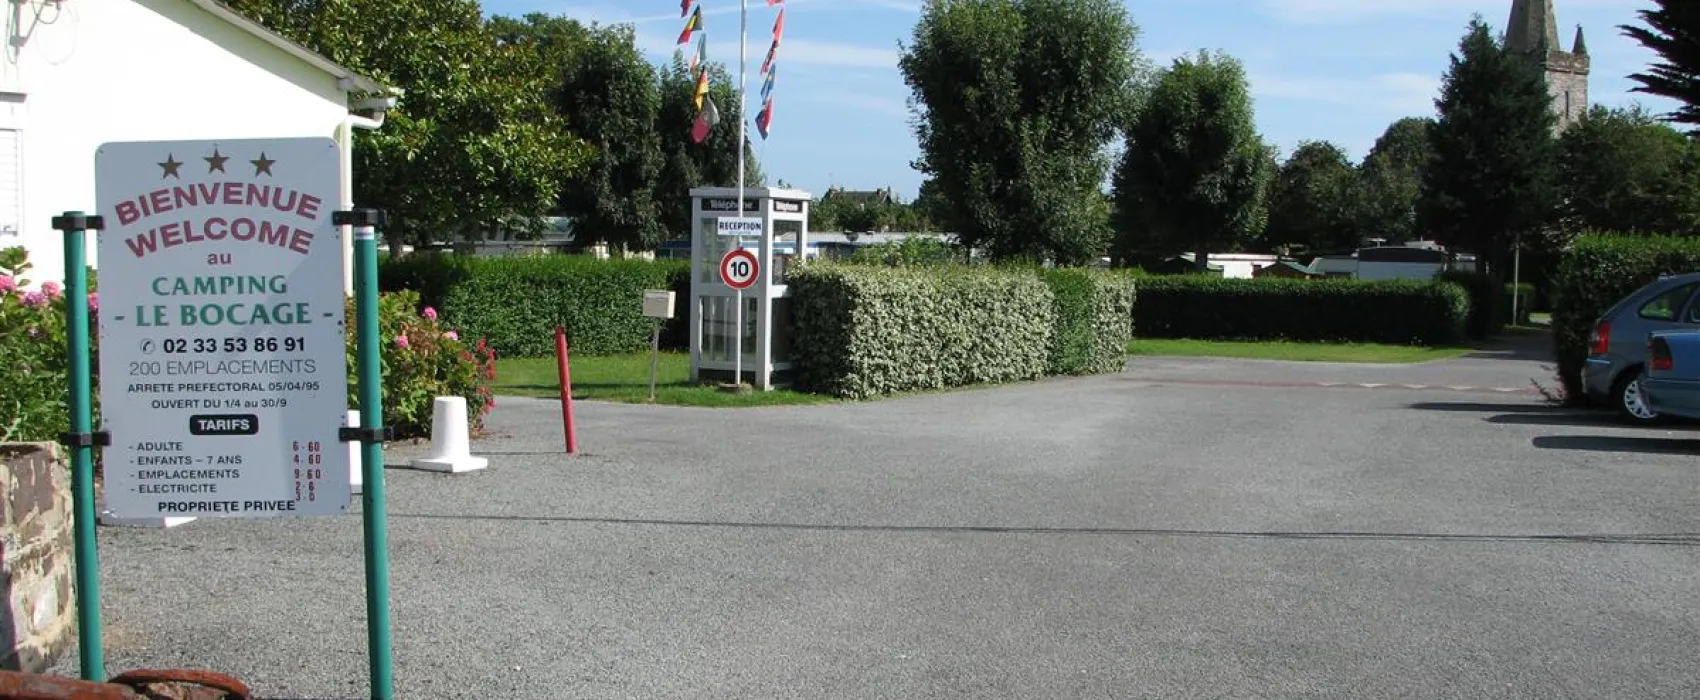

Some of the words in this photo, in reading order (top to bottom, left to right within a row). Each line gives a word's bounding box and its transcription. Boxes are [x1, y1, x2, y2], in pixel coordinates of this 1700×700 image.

[114, 182, 322, 226] BIENVENUE
[719, 221, 761, 231] RECEPTION
[125, 217, 314, 258] WELCOME
[207, 252, 231, 265] au
[731, 261, 749, 277] 10
[151, 275, 288, 296] CAMPING
[135, 305, 170, 327] LE
[180, 303, 312, 326] BOCAGE
[163, 339, 187, 353] 02
[193, 338, 217, 352] 33
[223, 338, 247, 352] 53
[254, 337, 278, 352] 86
[284, 337, 305, 351] 91
[129, 361, 161, 376] 200
[166, 358, 317, 375] EMPLACEMENTS
[128, 383, 175, 393] ARRETE
[178, 382, 265, 392] PREFECTORAL
[268, 380, 320, 391] 05/04/95
[151, 400, 200, 409] OUVERT
[203, 400, 221, 408] DU
[225, 399, 241, 408] 1/4
[244, 400, 259, 408] au
[261, 399, 287, 408] 30/9
[199, 419, 250, 431] TARIFS
[137, 442, 183, 451] ADULTE
[137, 456, 192, 466] ENFANTS
[207, 456, 213, 465] 7
[217, 455, 242, 464] ANS
[138, 470, 240, 479] EMPLACEMENTS
[139, 484, 217, 494] ELECTRICITE
[158, 502, 239, 513] PROPRIETE
[244, 501, 296, 511] PRIVEE
